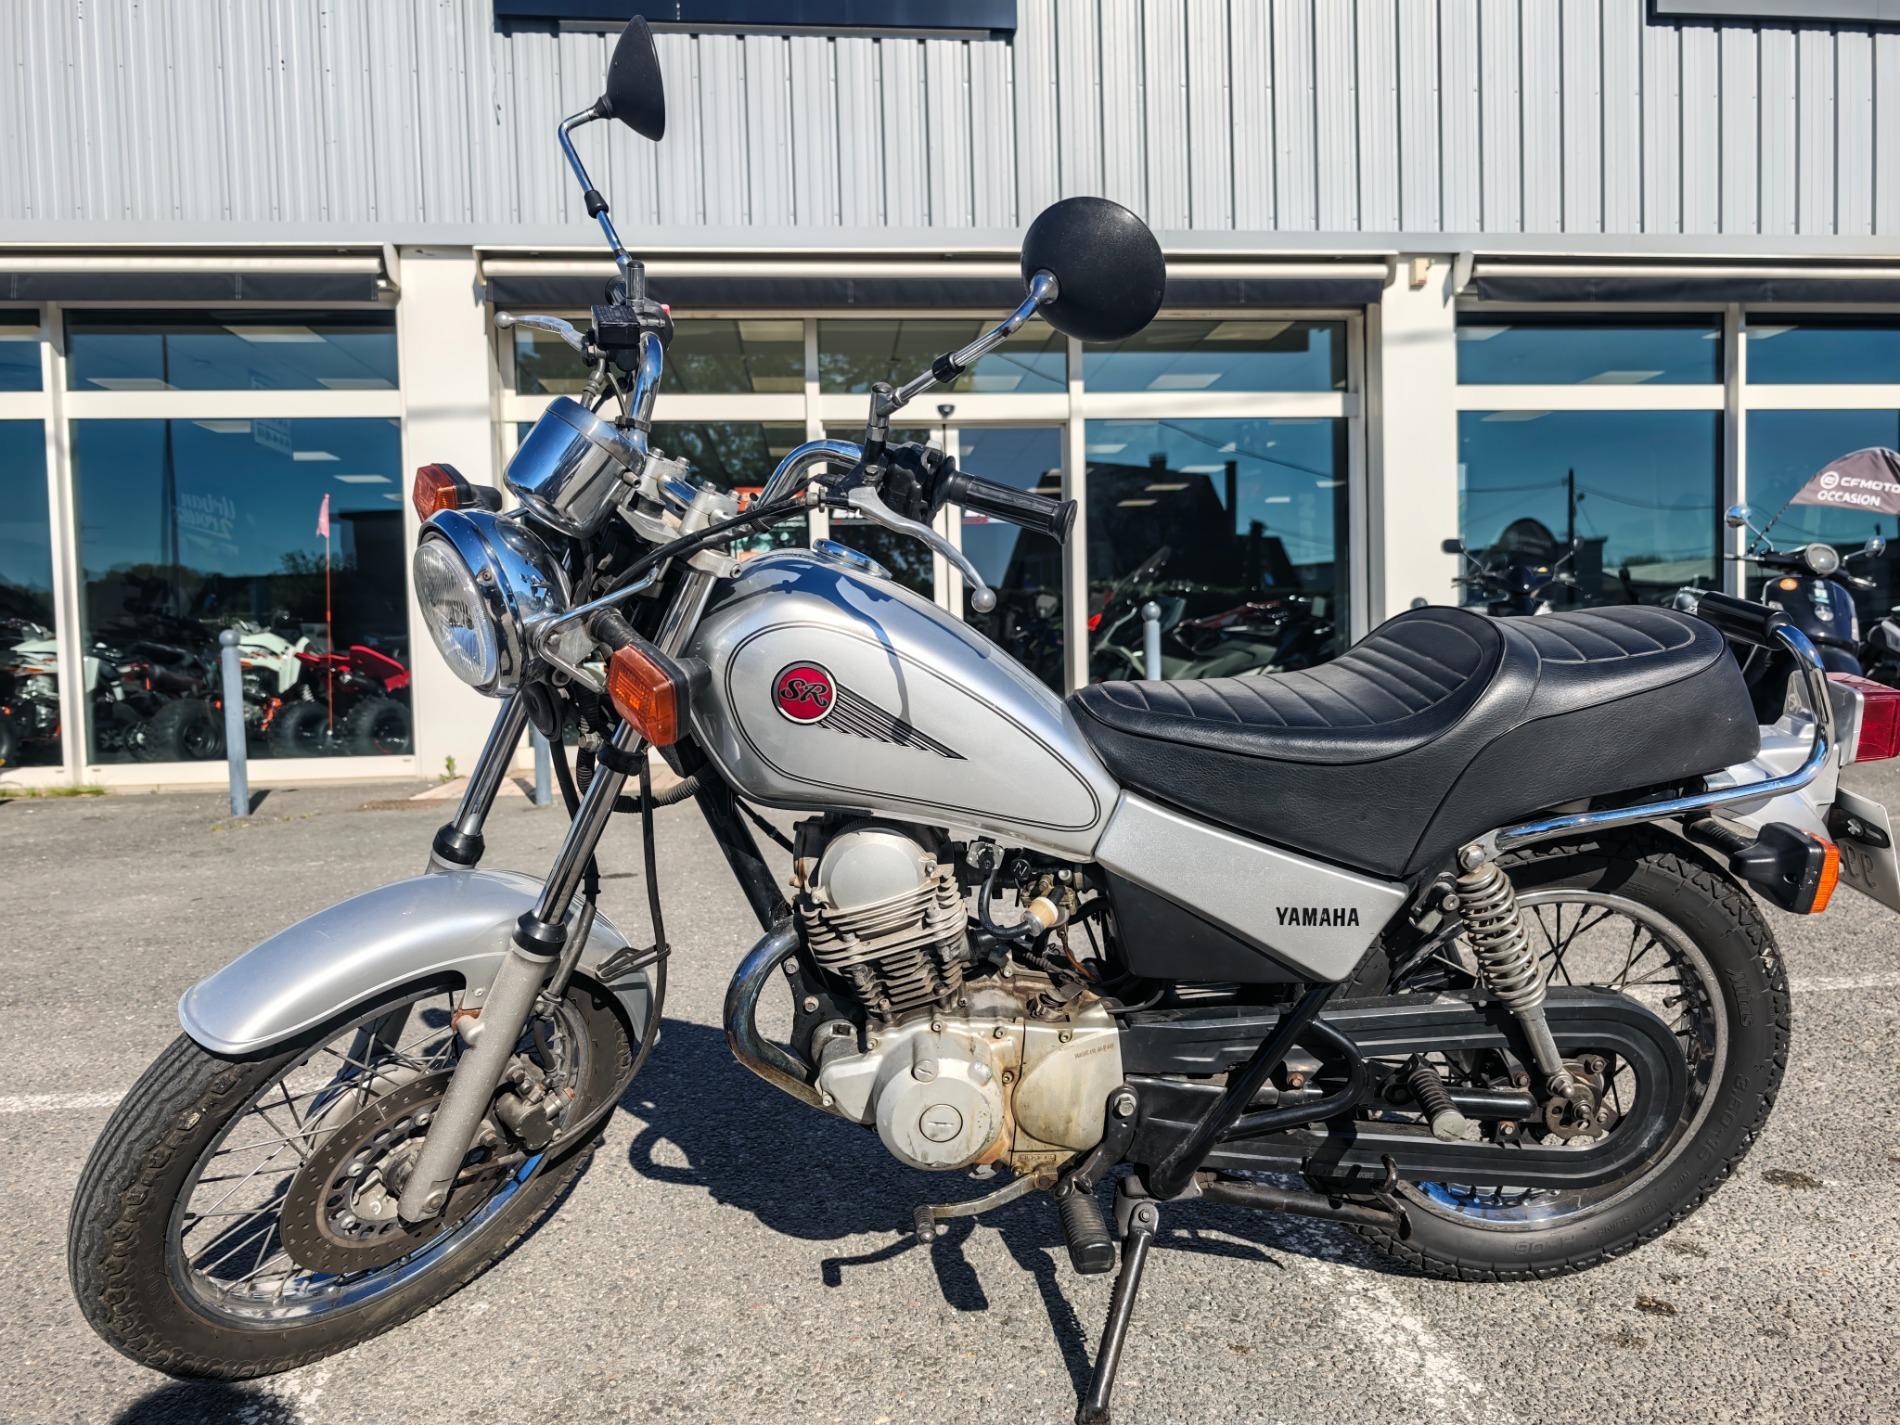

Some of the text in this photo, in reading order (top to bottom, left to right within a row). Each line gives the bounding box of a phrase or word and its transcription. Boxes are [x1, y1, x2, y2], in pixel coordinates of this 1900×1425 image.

[1841, 477, 1900, 494] CFMOTO
[1817, 490, 1880, 506] OCCASION
[780, 679, 828, 707] SR
[1275, 906, 1360, 927] YAMAHA
